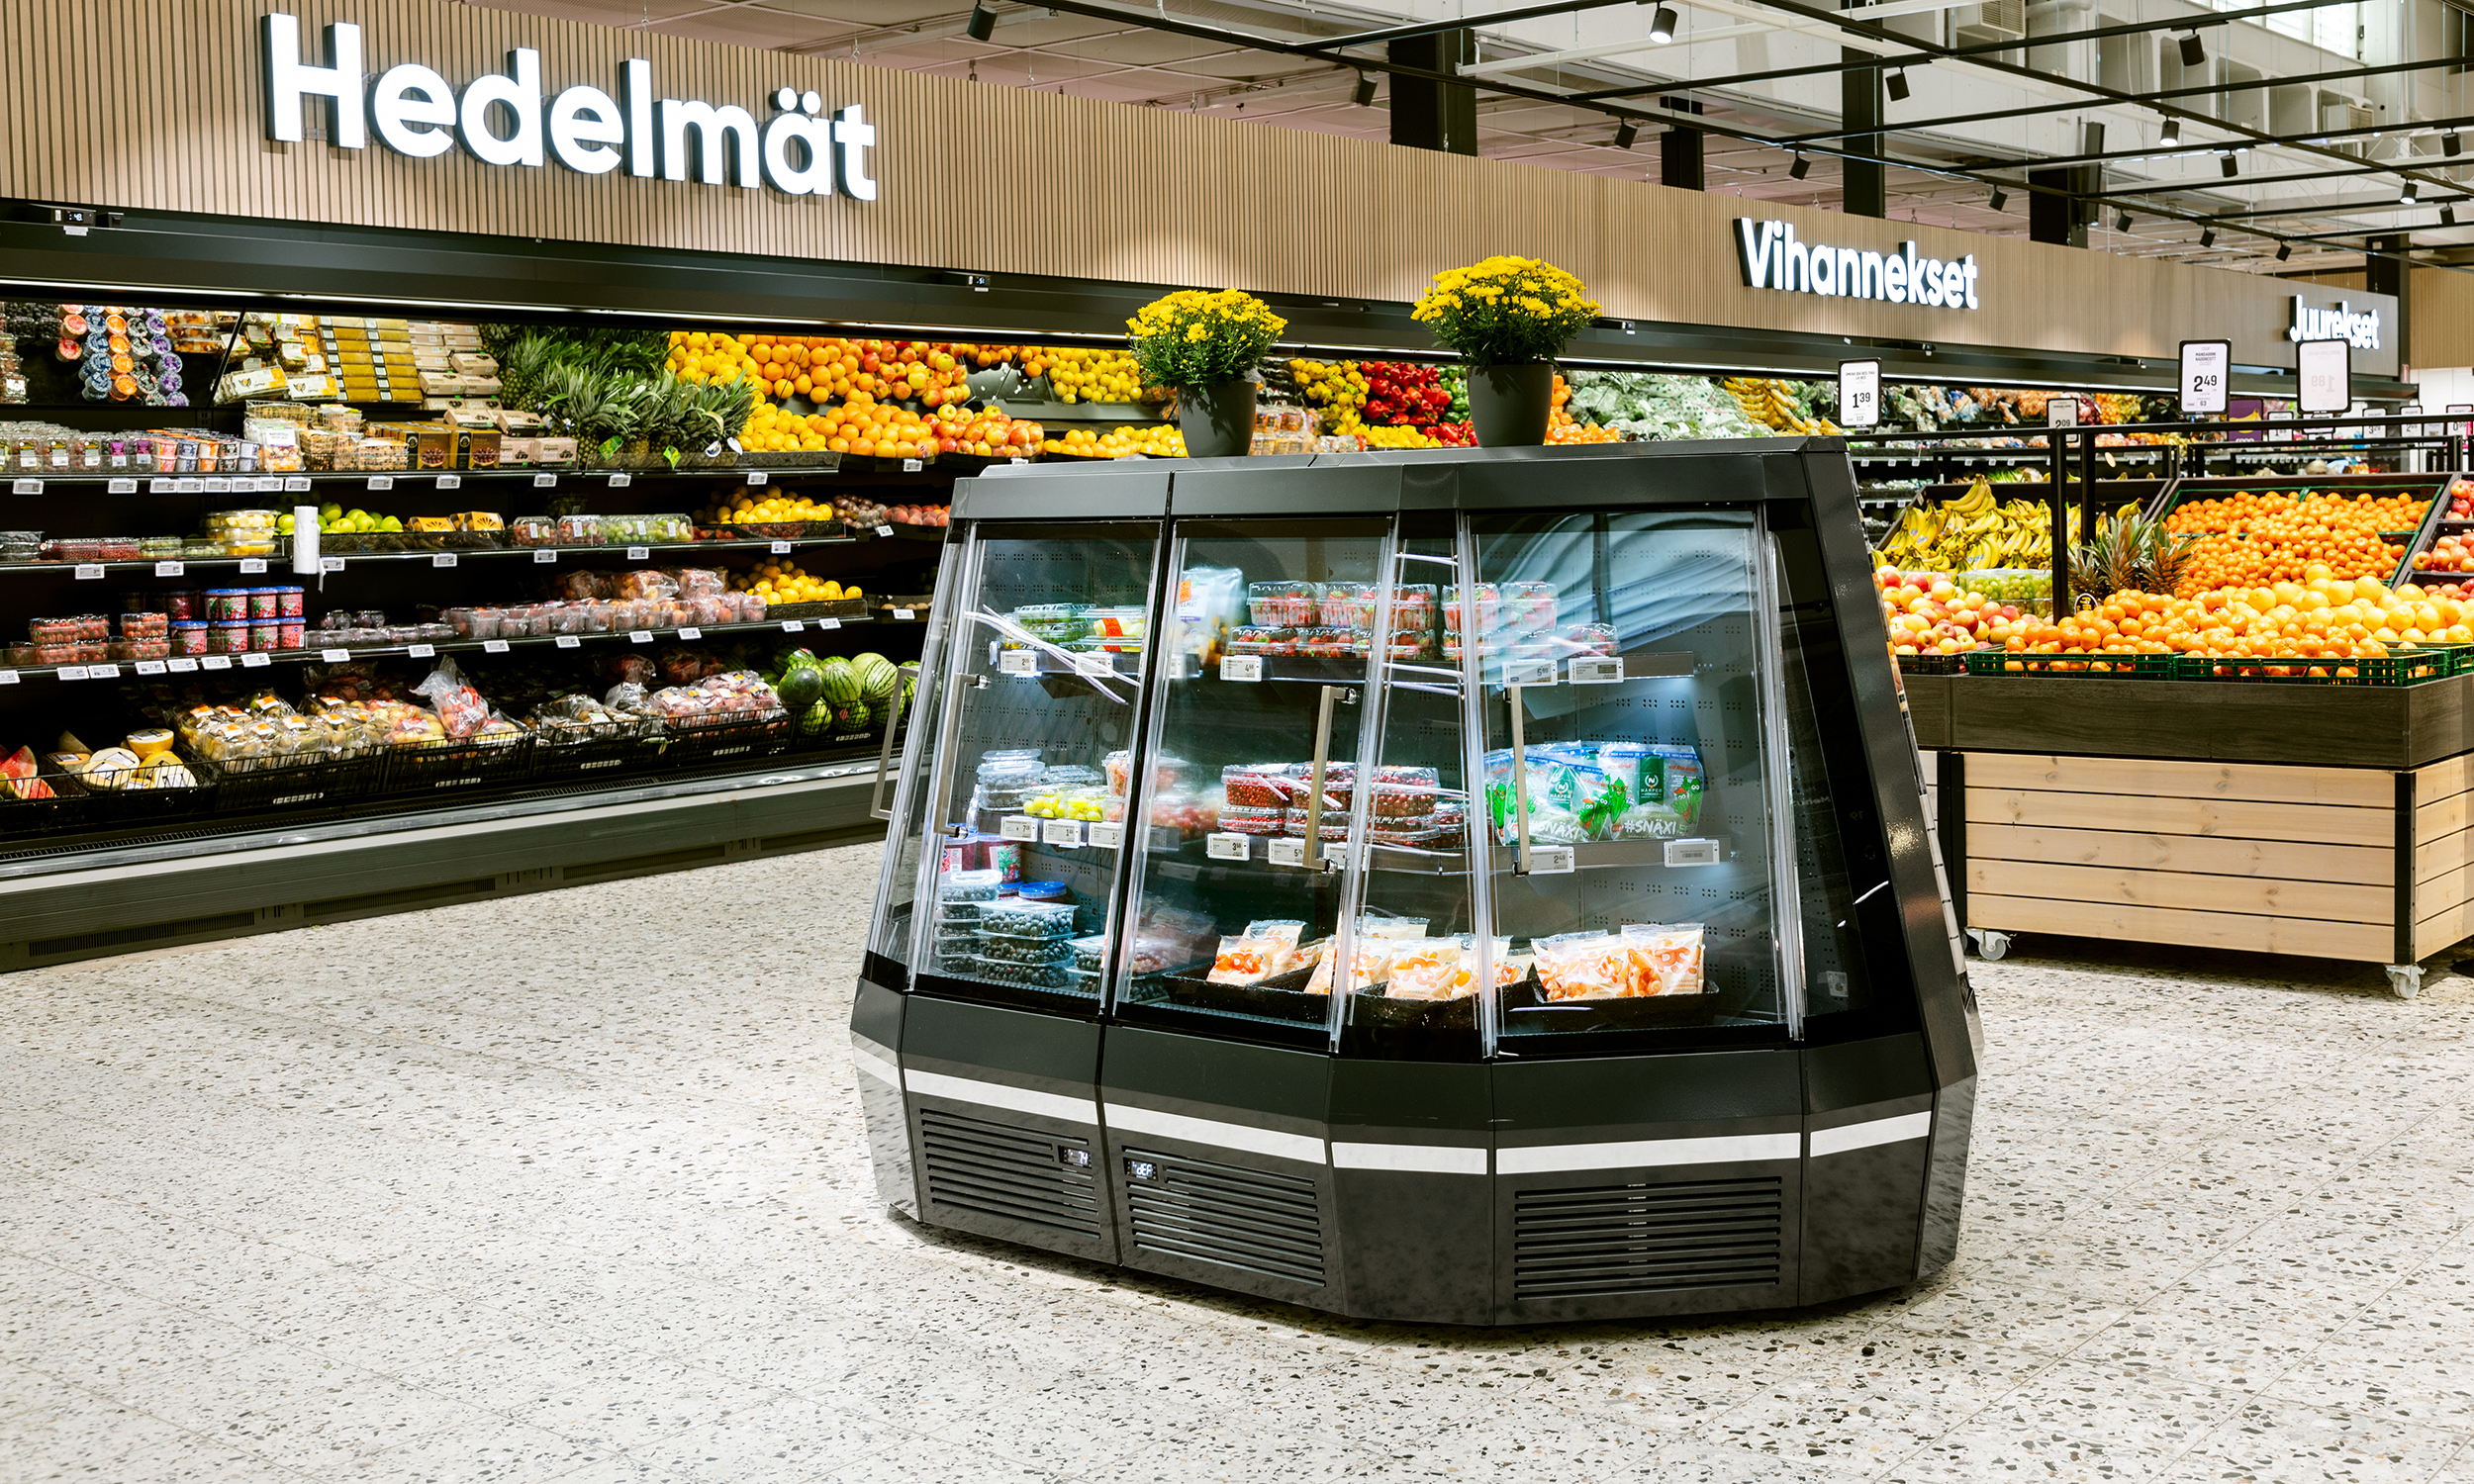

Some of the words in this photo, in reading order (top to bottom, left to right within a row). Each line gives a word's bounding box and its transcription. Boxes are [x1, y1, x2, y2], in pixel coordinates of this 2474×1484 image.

[264, 12, 877, 202] Hedelmät
[1737, 217, 1979, 311] Vihannekset
[2289, 294, 2380, 349] Juurekset
[1624, 819, 1677, 836] #SNÄXI
